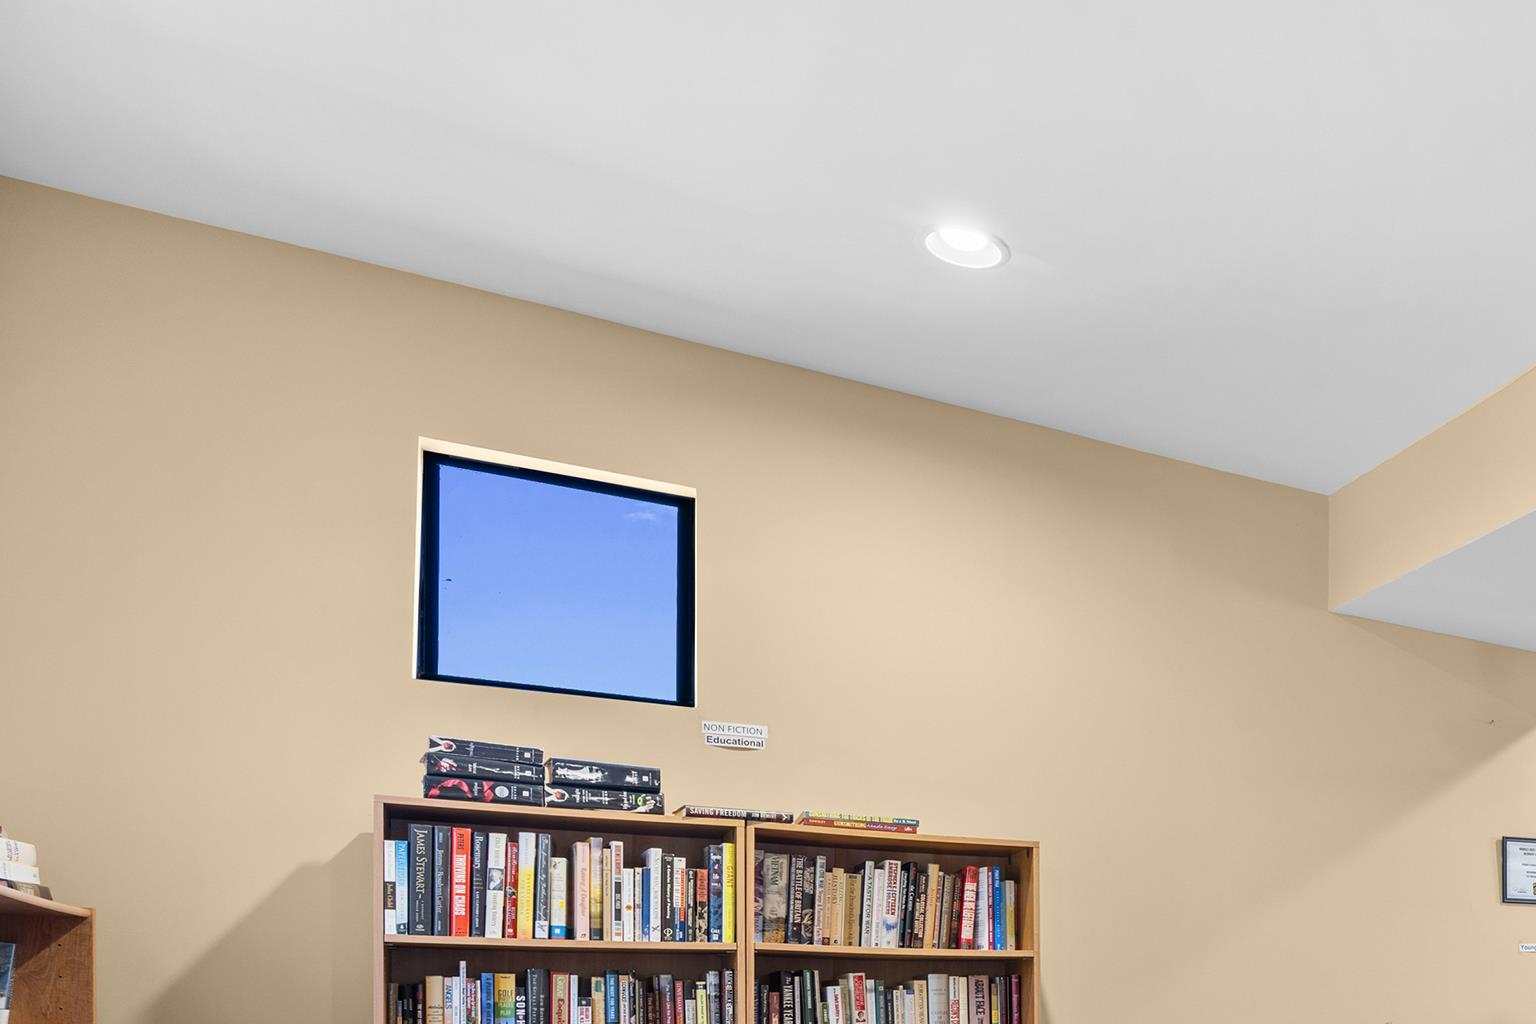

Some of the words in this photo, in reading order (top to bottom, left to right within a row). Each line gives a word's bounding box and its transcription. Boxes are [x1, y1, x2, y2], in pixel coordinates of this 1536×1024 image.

[704, 723, 724, 732] NON
[728, 726, 762, 735] FICTION
[707, 736, 763, 747] Educational
[690, 807, 714, 816] SAVING
[715, 808, 747, 818] FREEDOM
[414, 829, 428, 855] JAMES
[473, 836, 483, 870] Rosemary
[416, 857, 428, 893] STEWART
[455, 854, 466, 883] THRIVING
[456, 885, 466, 893] ON
[456, 896, 466, 916] CHAOS
[783, 985, 793, 1008] YANKEE
[975, 979, 985, 999] ABOUT
[516, 995, 526, 1015] SON
[976, 1000, 985, 1015] FACE
